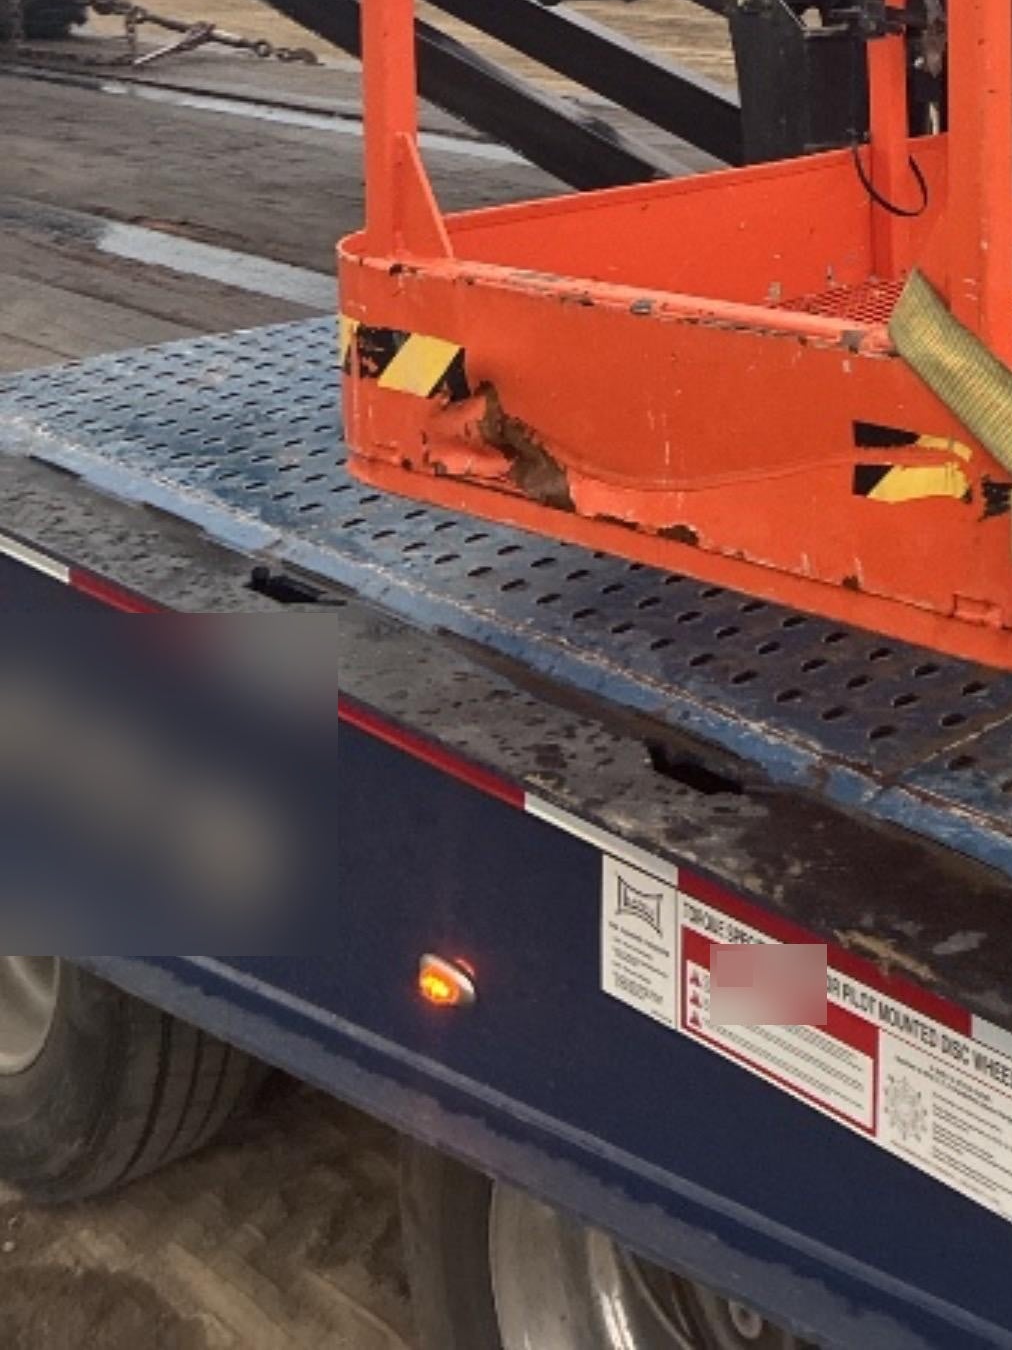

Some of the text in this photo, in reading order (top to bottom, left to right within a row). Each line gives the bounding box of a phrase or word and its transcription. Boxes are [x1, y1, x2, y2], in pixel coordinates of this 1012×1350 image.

[842, 983, 876, 1015] PILOT
[878, 999, 938, 1048] MOUNTED
[941, 1033, 970, 1065] DISC
